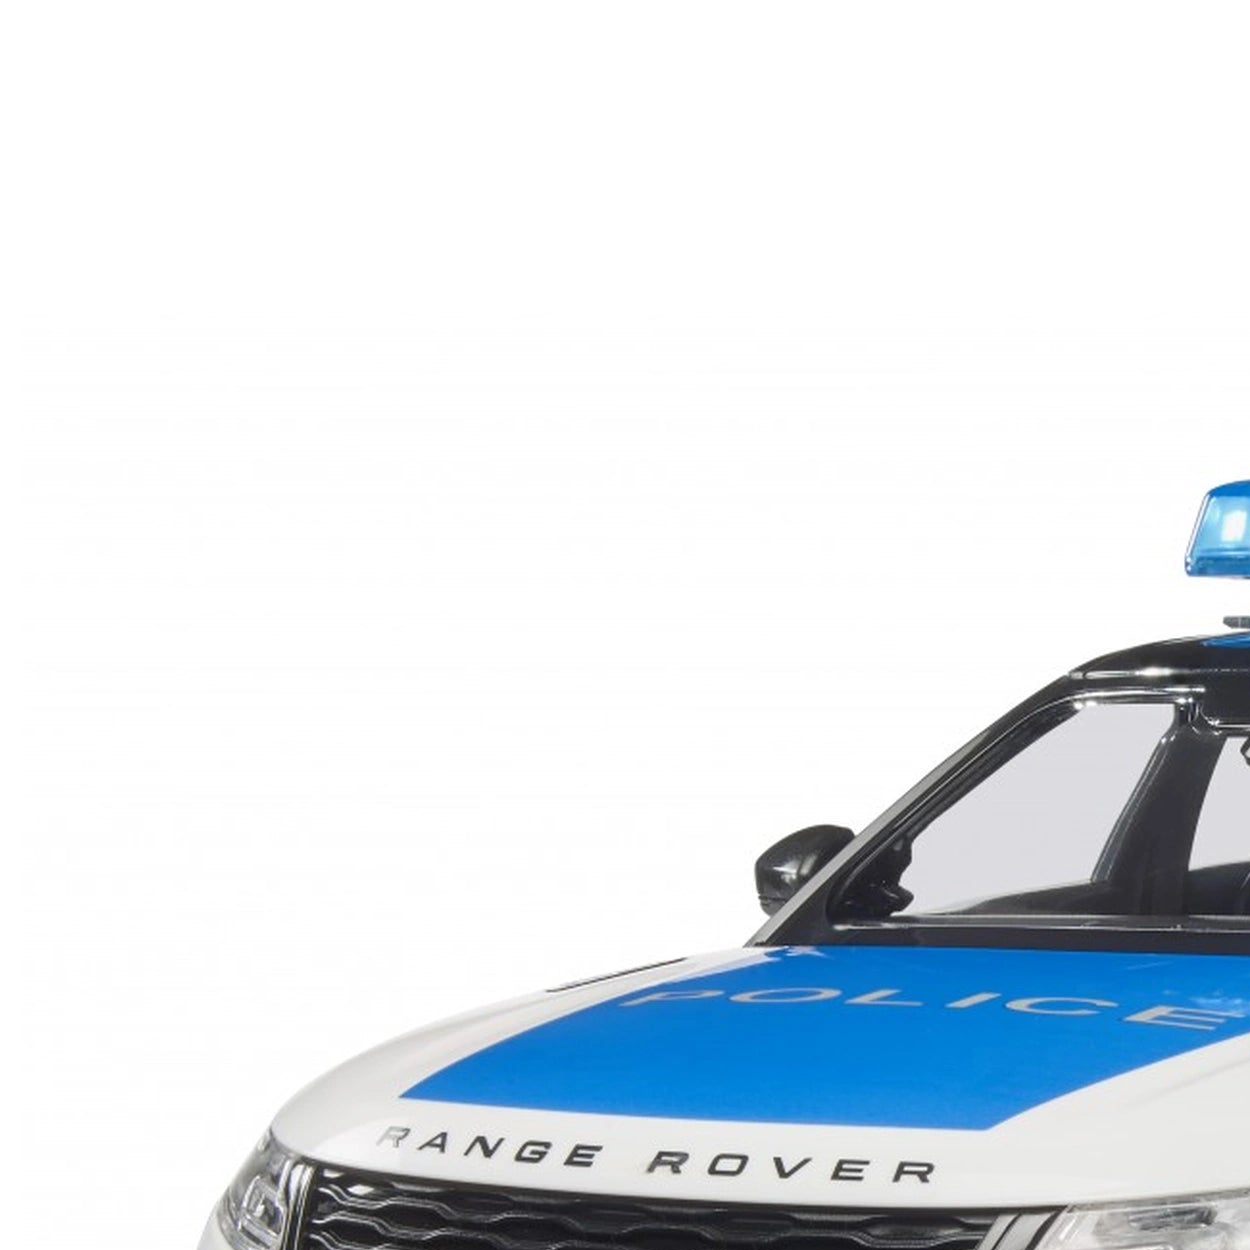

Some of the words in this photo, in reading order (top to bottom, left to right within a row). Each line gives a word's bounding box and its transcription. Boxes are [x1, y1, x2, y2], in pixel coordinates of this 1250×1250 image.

[620, 987, 1245, 1030] POLICE
[376, 1125, 603, 1168] RANGE
[646, 1150, 935, 1183] ROVER
